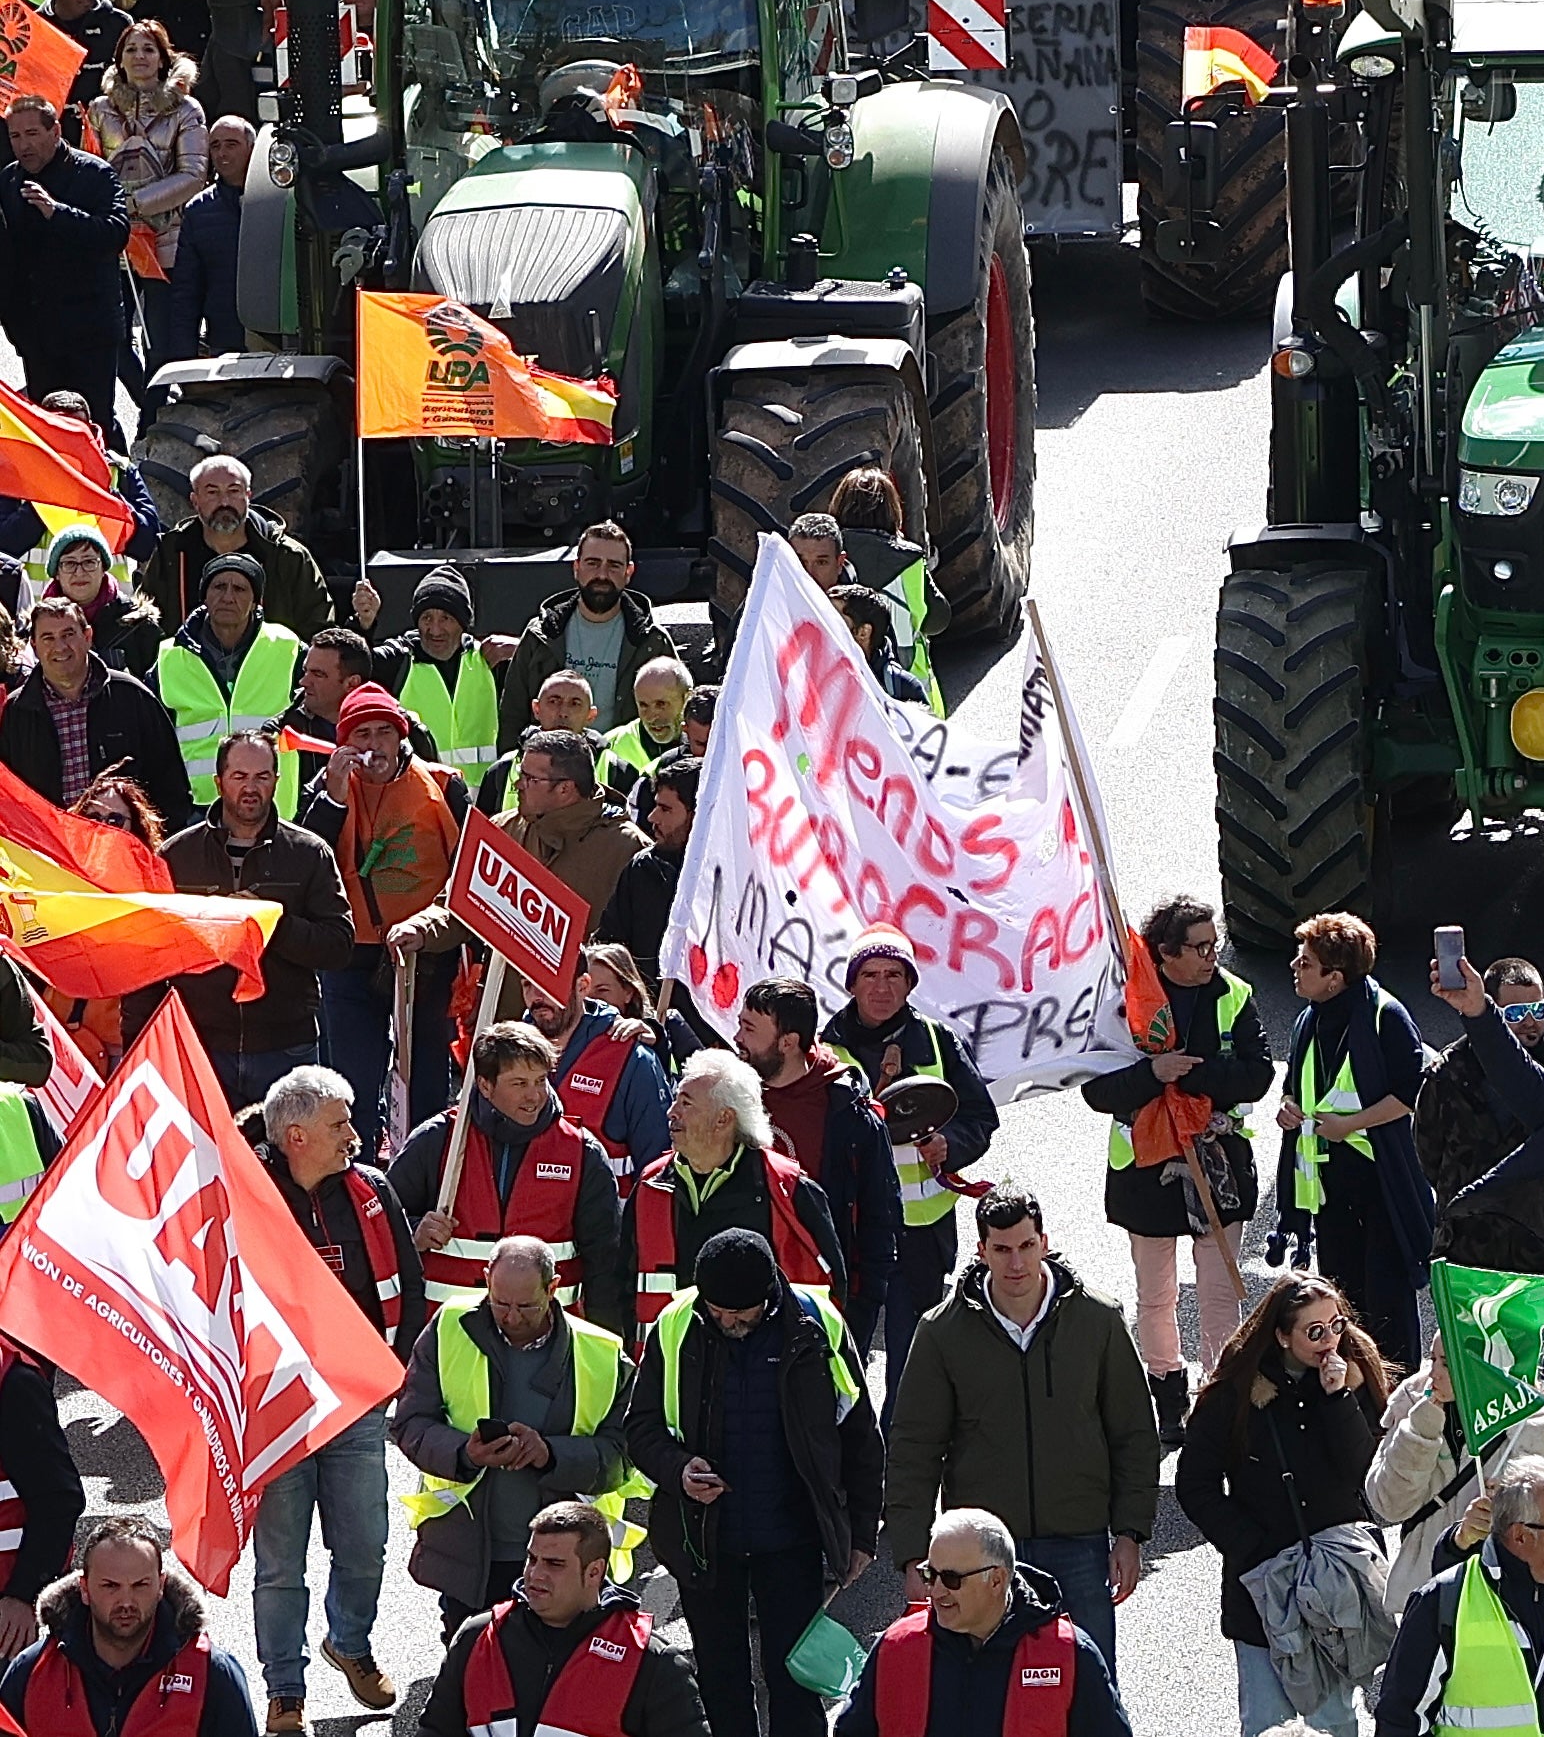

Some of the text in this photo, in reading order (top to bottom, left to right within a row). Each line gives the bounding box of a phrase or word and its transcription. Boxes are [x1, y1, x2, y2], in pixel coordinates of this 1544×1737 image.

[423, 360, 491, 393] UPA
[477, 847, 570, 945] UAGN
[573, 1074, 602, 1089] UAGN
[538, 1164, 570, 1174] UAGN
[20, 1235, 59, 1281] NIÓN
[61, 1271, 85, 1301] DE
[84, 1291, 186, 1389] AGRICULTORES
[191, 1391, 231, 1477] GANADEROS
[1472, 1374, 1540, 1435] ASAJA
[592, 1637, 625, 1656] UAGN
[1023, 1668, 1060, 1680] UAGN
